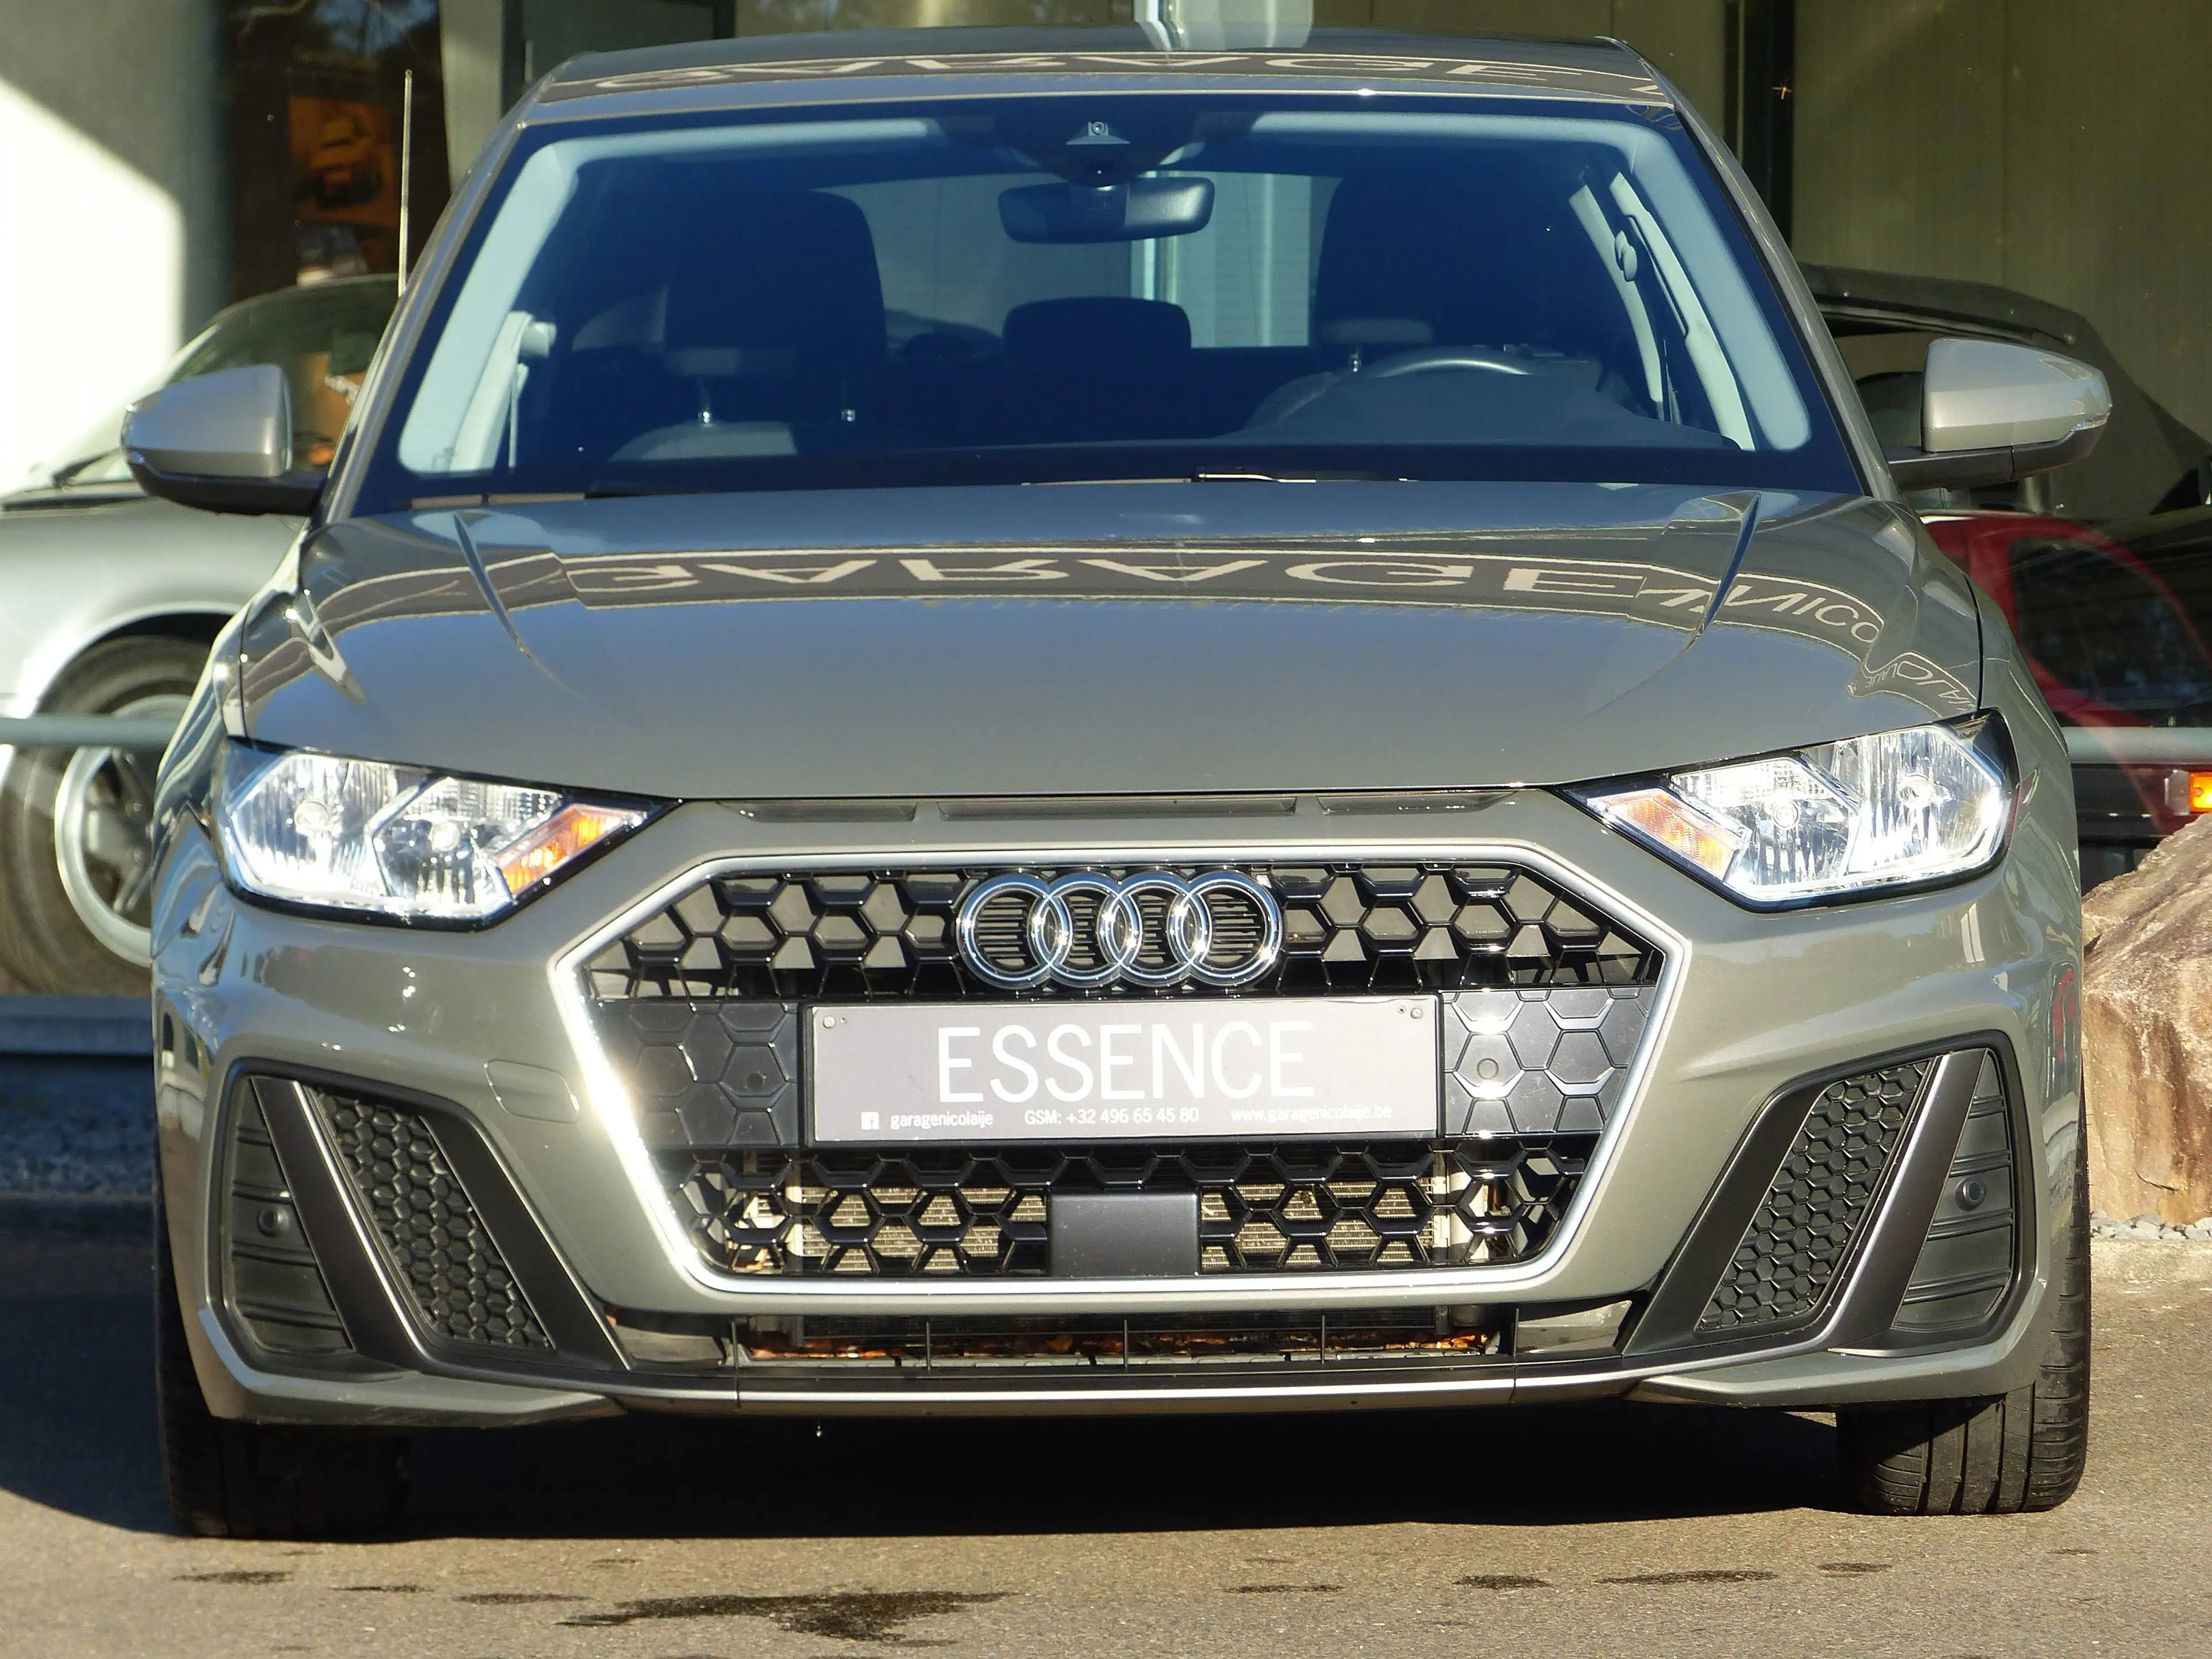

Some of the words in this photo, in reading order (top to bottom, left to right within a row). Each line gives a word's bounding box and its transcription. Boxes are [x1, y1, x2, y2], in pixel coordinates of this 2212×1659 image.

[938, 1021, 1315, 1103] ESSENCE
[890, 1111, 994, 1130] garagenicolaije
[1024, 1109, 1062, 1125] GSM:
[1066, 1108, 1096, 1124] +32
[1100, 1108, 1129, 1123] 496
[1133, 1107, 1153, 1123] 65
[1157, 1107, 1176, 1123] 45
[1180, 1107, 1200, 1123] 80
